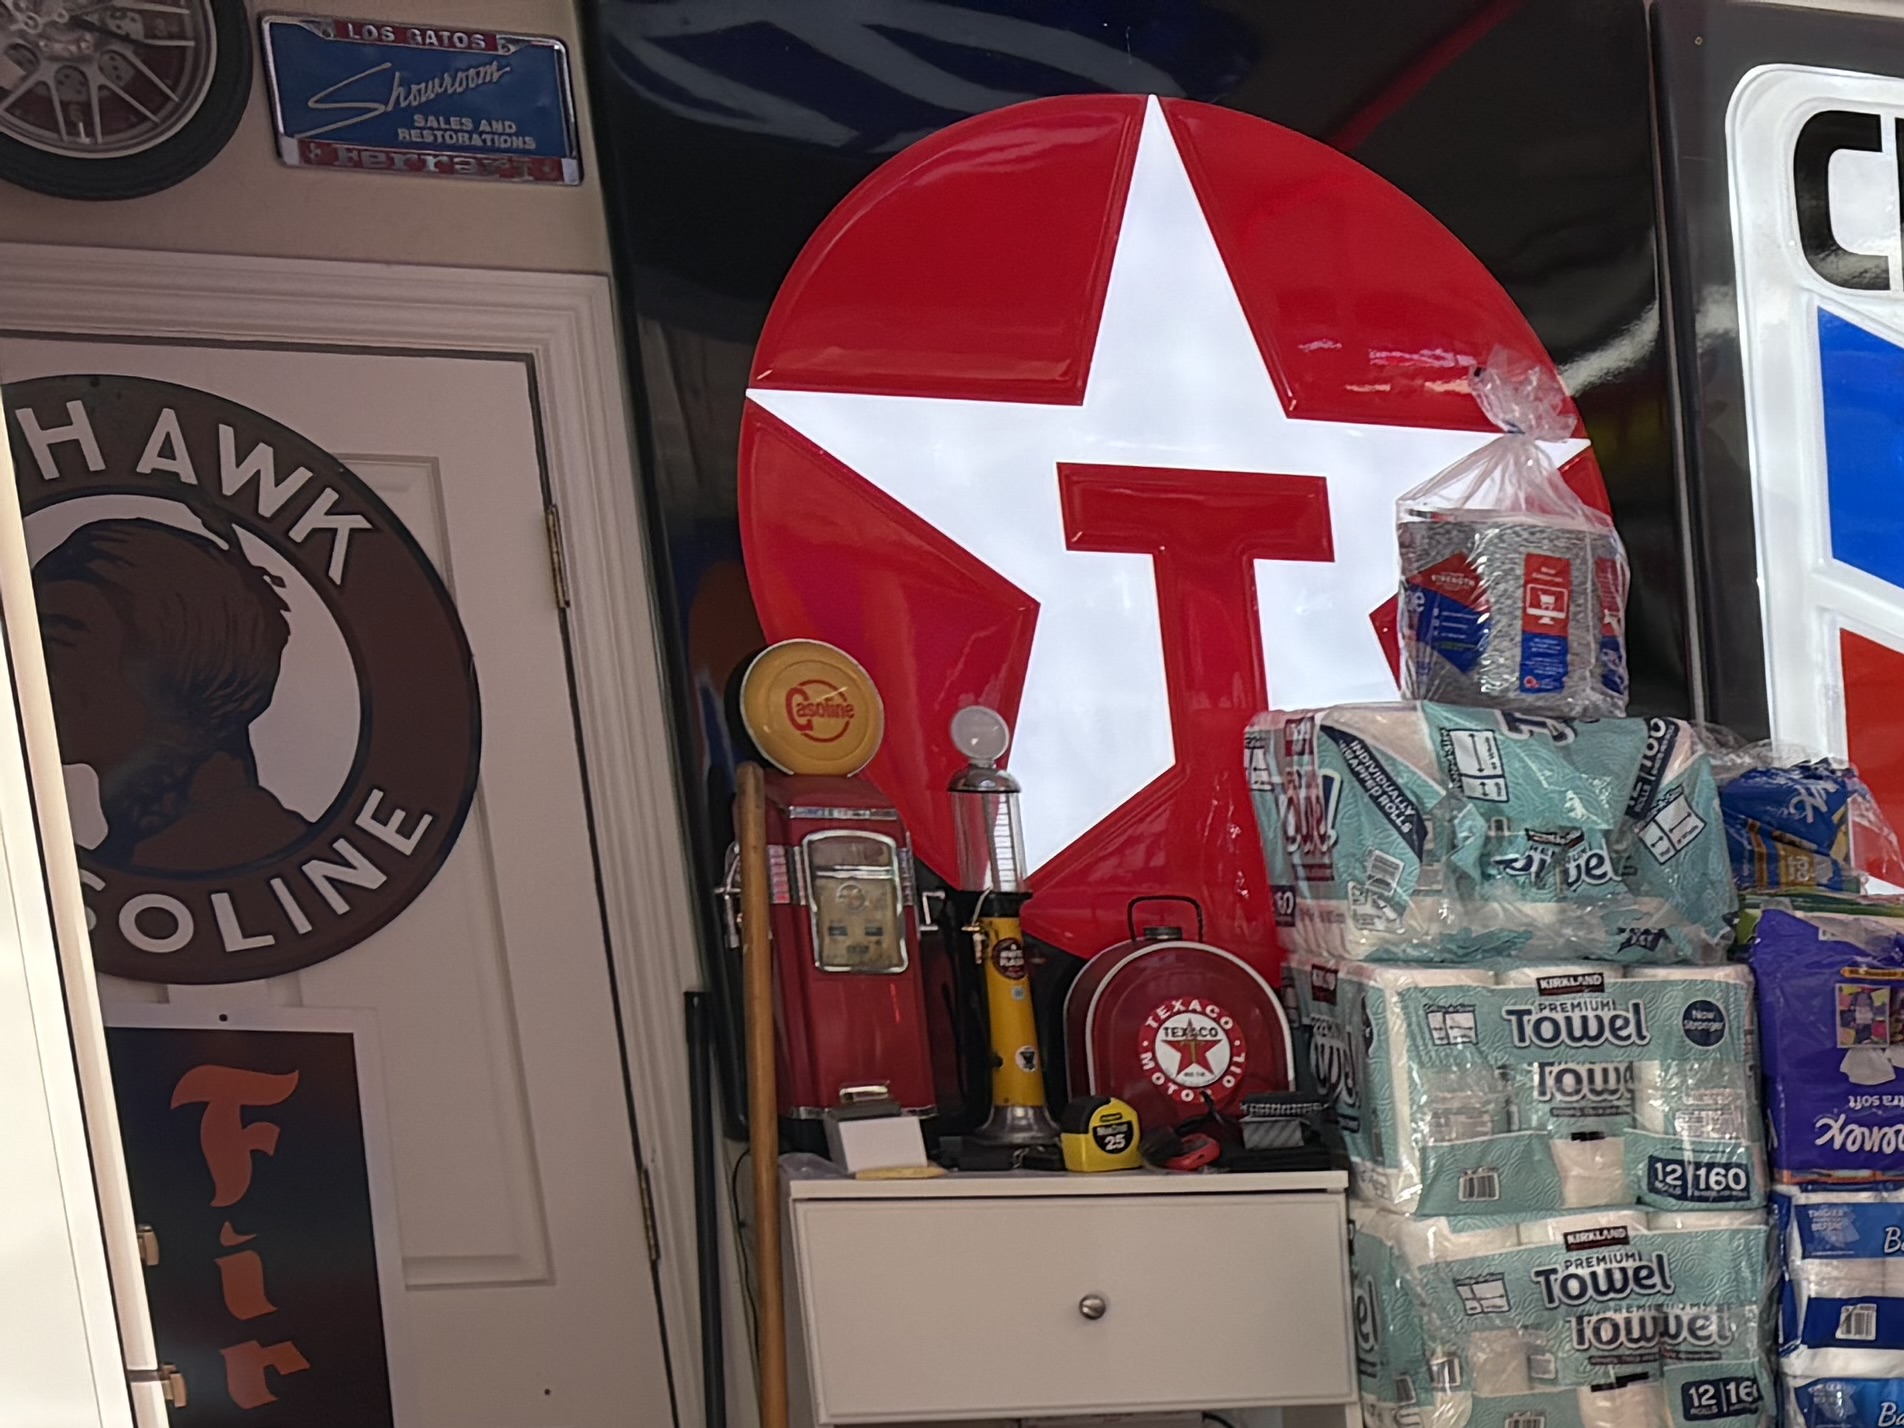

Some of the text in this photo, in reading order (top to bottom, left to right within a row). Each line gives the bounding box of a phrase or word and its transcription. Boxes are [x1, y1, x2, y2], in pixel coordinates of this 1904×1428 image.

[348, 23, 485, 49] LOS GATOS
[294, 60, 511, 138] Showroom
[397, 128, 536, 149] RESTORATIONS
[413, 114, 516, 133] SALES AND
[336, 149, 536, 181] Ferrari
[15, 400, 375, 586] HAWK
[1350, 740, 1416, 817] INDIVIDUALLY
[1377, 792, 1413, 834] ROLLS
[82, 789, 432, 954] OLINE
[1539, 974, 1603, 990] KIRKLAND
[1145, 999, 1233, 1030] TEXACO
[1504, 1001, 1649, 1047] Towel
[1223, 1052, 1246, 1088] OIL
[1849, 1094, 1878, 1108] soft
[1104, 1133, 1126, 1151] 25
[1654, 1162, 1747, 1191] 12 160
[1567, 1227, 1627, 1245] KIRKLAND
[1534, 1252, 1673, 1308] Towel
[1689, 1385, 1717, 1407] 12
